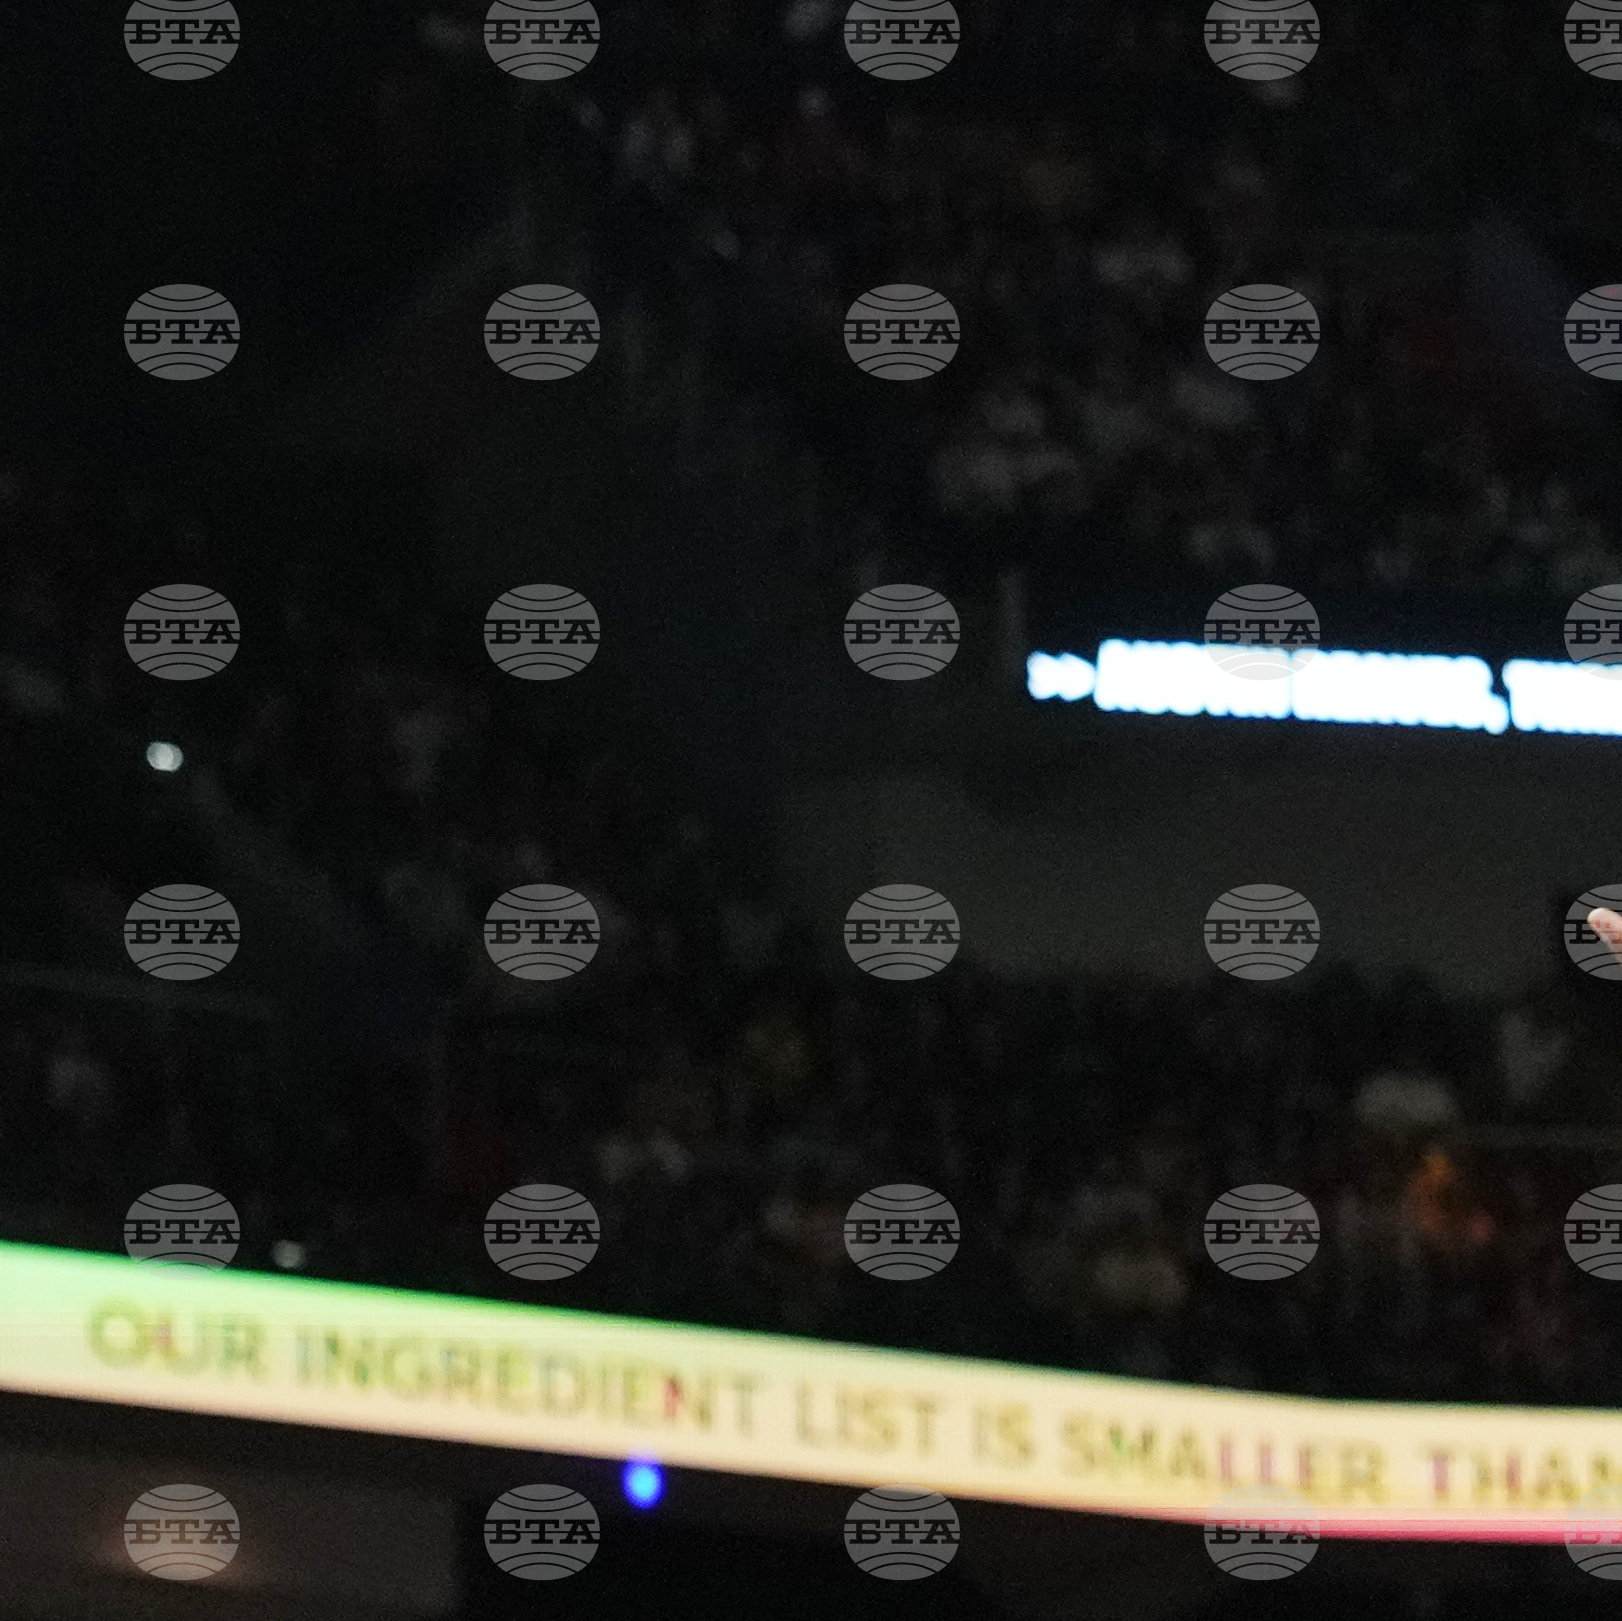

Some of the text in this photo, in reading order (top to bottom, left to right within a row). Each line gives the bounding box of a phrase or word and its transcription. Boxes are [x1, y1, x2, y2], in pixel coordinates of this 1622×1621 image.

[86, 1297, 268, 1384] OUR
[295, 1326, 764, 1438] INGREDIENT
[796, 1380, 943, 1460] LIST
[973, 1403, 1037, 1471] IS
[1062, 1410, 1392, 1506] SMALLER
